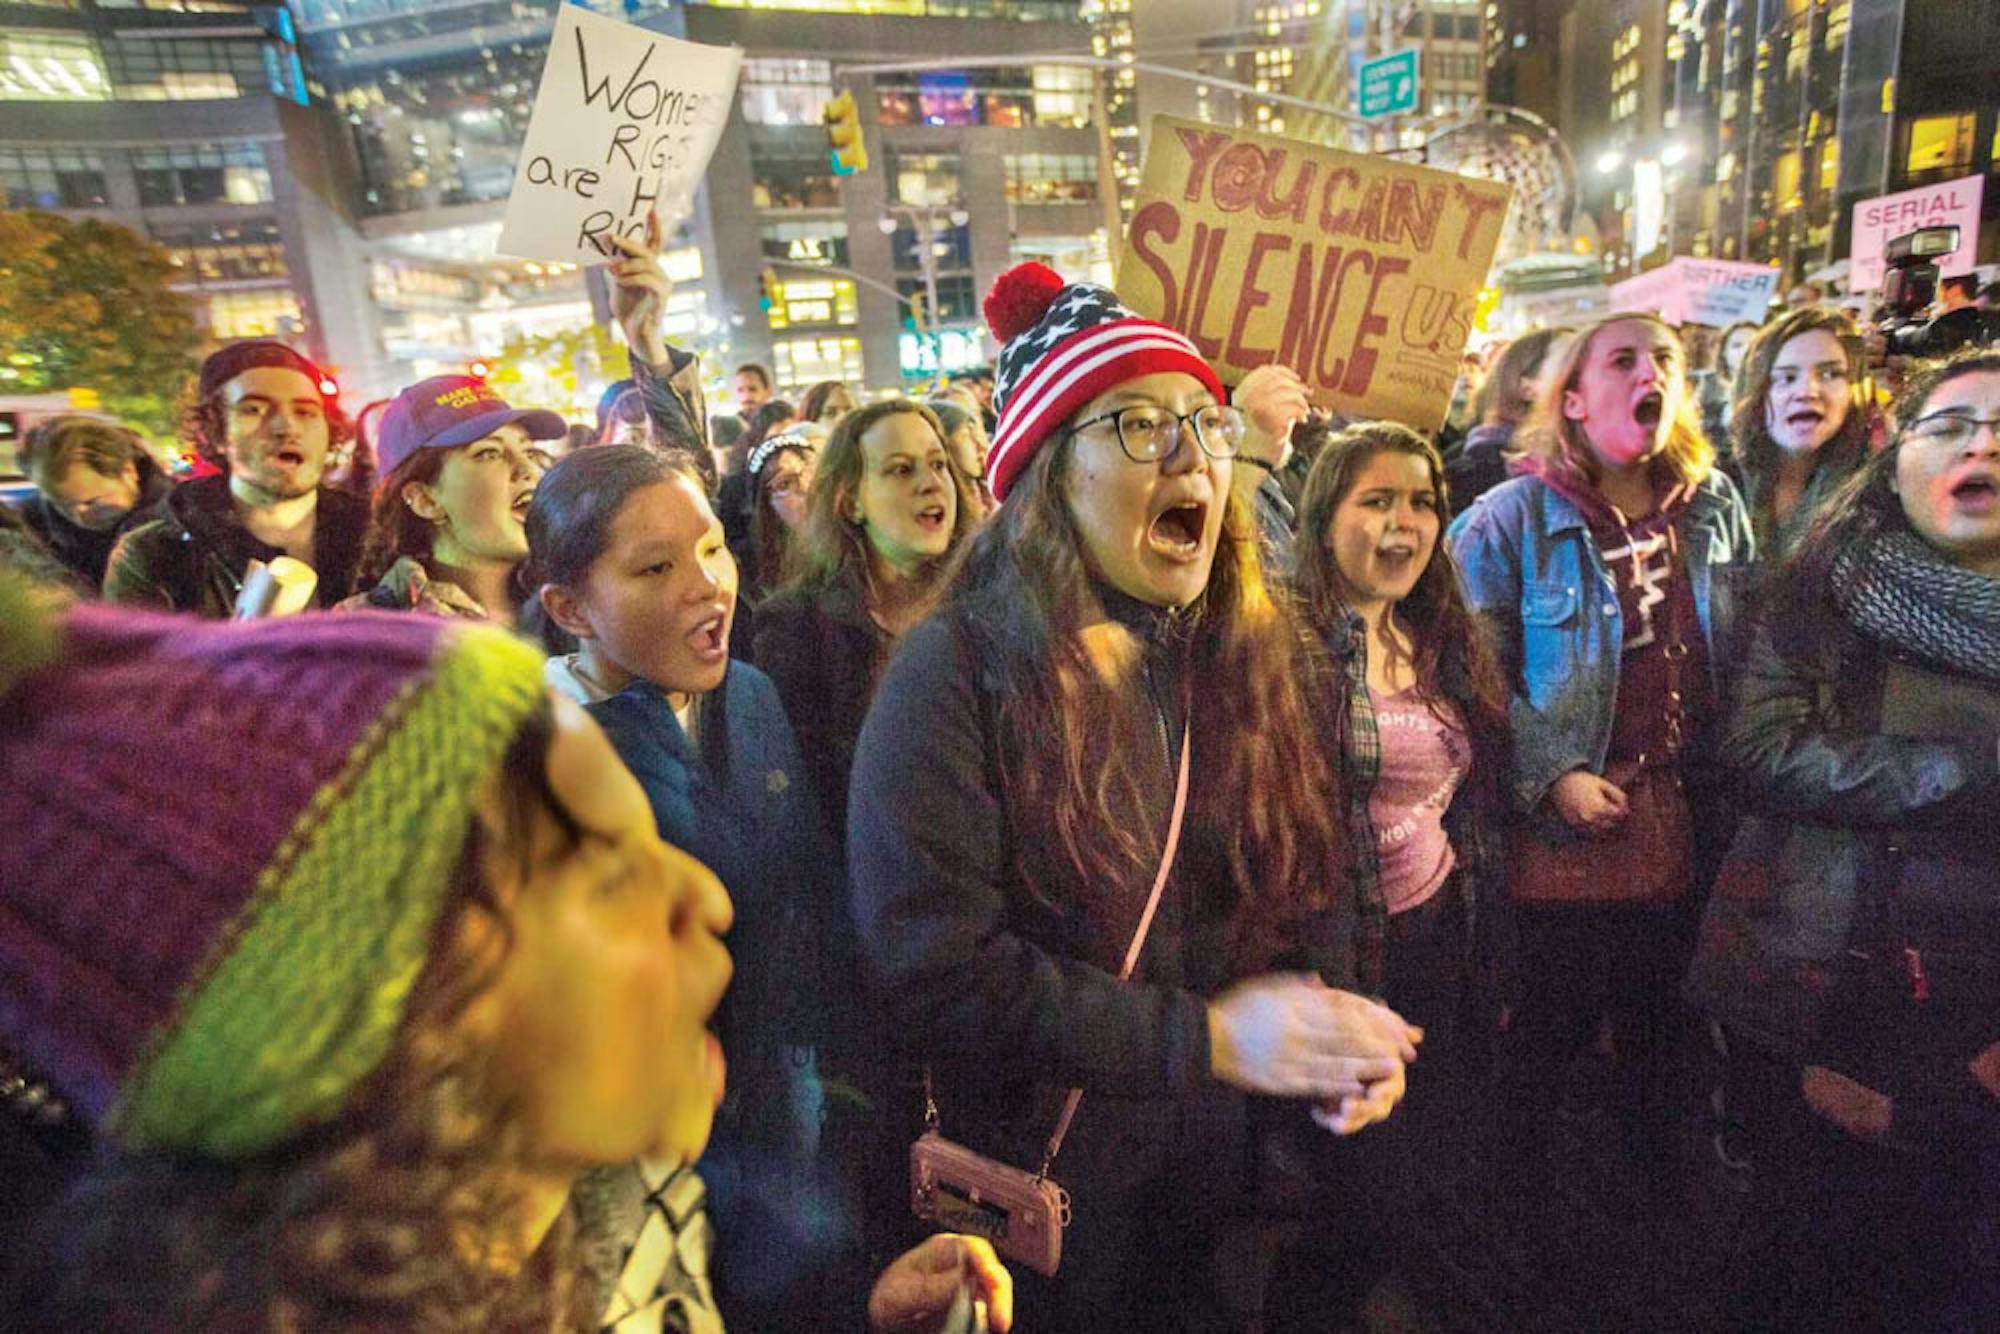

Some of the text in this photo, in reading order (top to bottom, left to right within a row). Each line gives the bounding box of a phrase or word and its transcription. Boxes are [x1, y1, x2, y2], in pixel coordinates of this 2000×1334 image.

[527, 156, 600, 198] are
[1175, 127, 1318, 224] YOU
[1864, 191, 1966, 227] SERIAL
[1131, 201, 1411, 398] SILENCE
